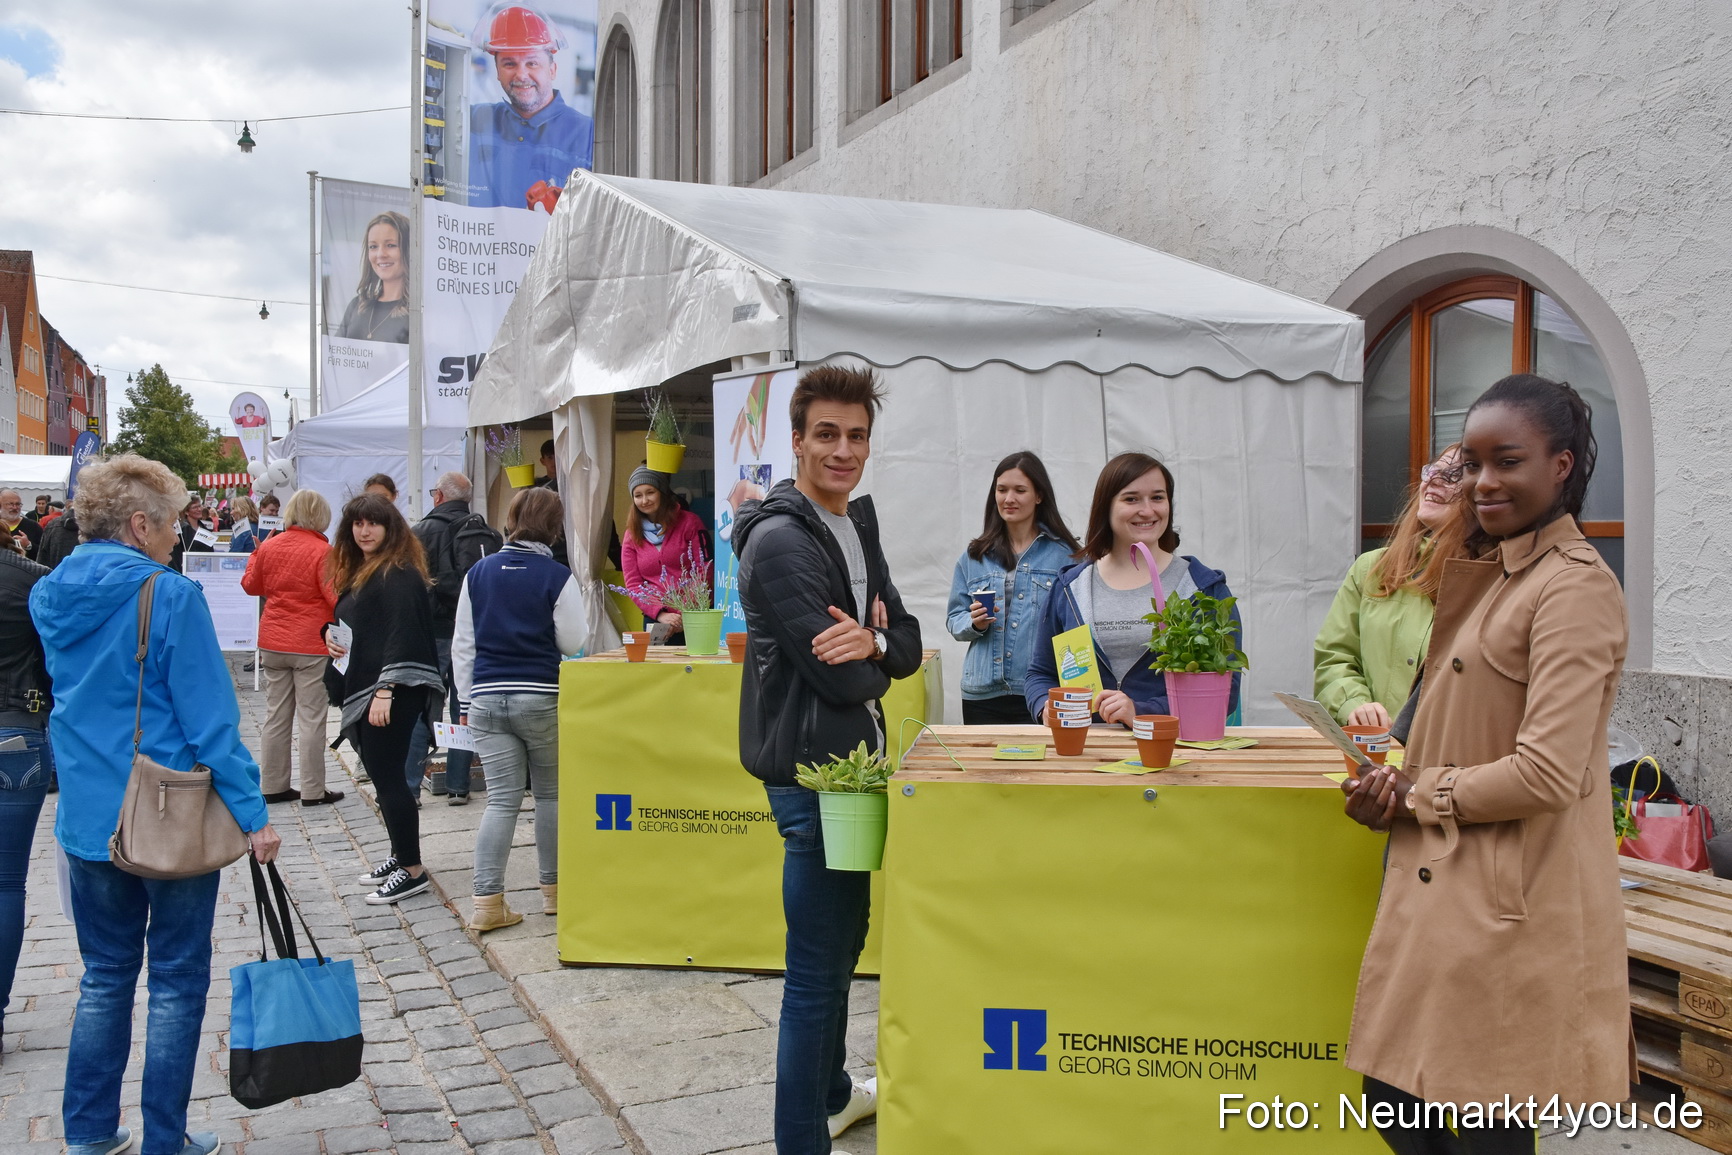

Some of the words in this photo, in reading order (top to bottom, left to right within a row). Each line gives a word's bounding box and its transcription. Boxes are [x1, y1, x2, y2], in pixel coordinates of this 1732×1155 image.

[437, 214, 459, 233] FÜR
[462, 221, 495, 236] IHRE
[437, 257, 468, 276] GEBE
[473, 262, 496, 276] ICH
[436, 278, 490, 295] GRÜNES
[328, 345, 374, 358] PERSÖNLICH
[327, 356, 341, 366] FÜR
[343, 359, 355, 368] SIE
[356, 361, 369, 369] DA!
[638, 808, 710, 820] TECHNISCHE
[638, 820, 678, 833] GEORG
[681, 822, 718, 834] SIMON
[721, 824, 748, 835] OHM
[1691, 994, 1720, 1017] EPAL
[1058, 1033, 1188, 1056] TECHNISCHE
[1194, 1038, 1339, 1061] HOCHSCHULE
[1058, 1055, 1131, 1077] GEORG
[1136, 1058, 1202, 1079] SIMON
[1208, 1061, 1257, 1081] OHM
